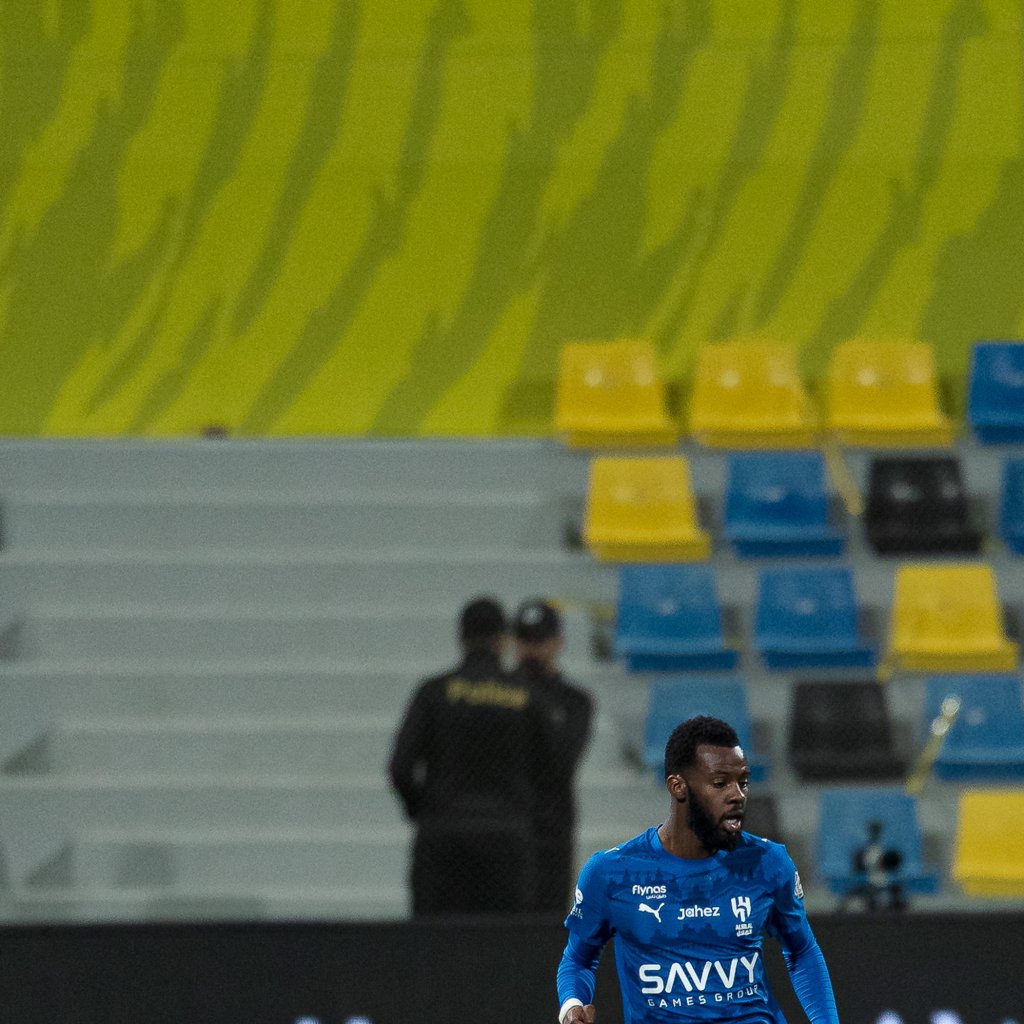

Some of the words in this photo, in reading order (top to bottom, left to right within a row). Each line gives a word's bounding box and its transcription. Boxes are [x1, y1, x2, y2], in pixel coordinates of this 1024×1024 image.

[632, 885, 667, 896] flynas
[639, 951, 759, 994] SAVVY
[647, 995, 707, 1008] GAMES
[714, 984, 759, 1002] GROUP
